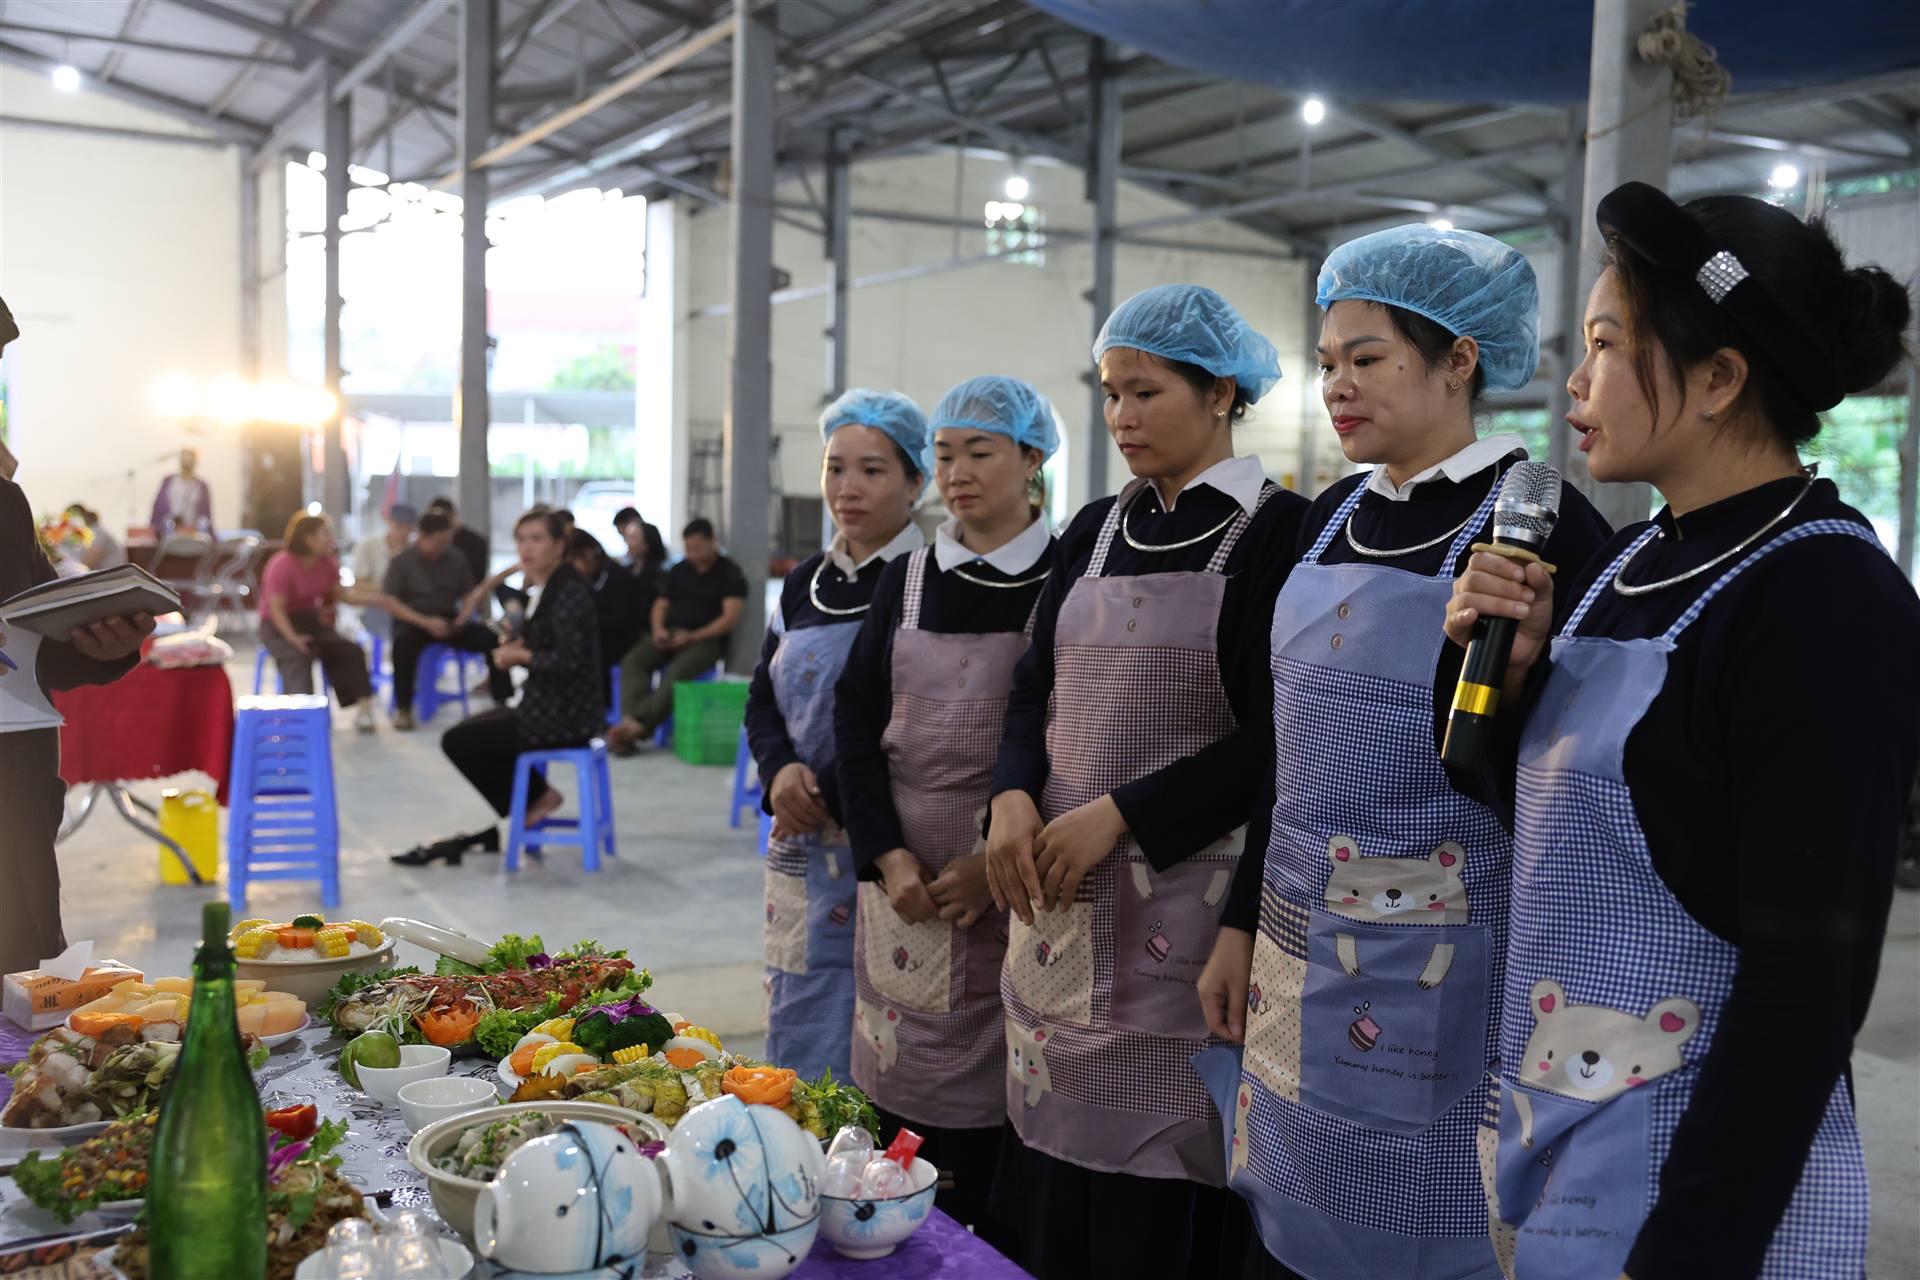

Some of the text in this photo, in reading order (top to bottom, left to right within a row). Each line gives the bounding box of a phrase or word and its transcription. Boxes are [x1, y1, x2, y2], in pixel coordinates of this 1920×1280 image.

[1387, 1043, 1405, 1055] like
[1408, 1047, 1439, 1061] honey
[1334, 1055, 1369, 1072] Yummy
[1371, 1064, 1404, 1078] honey
